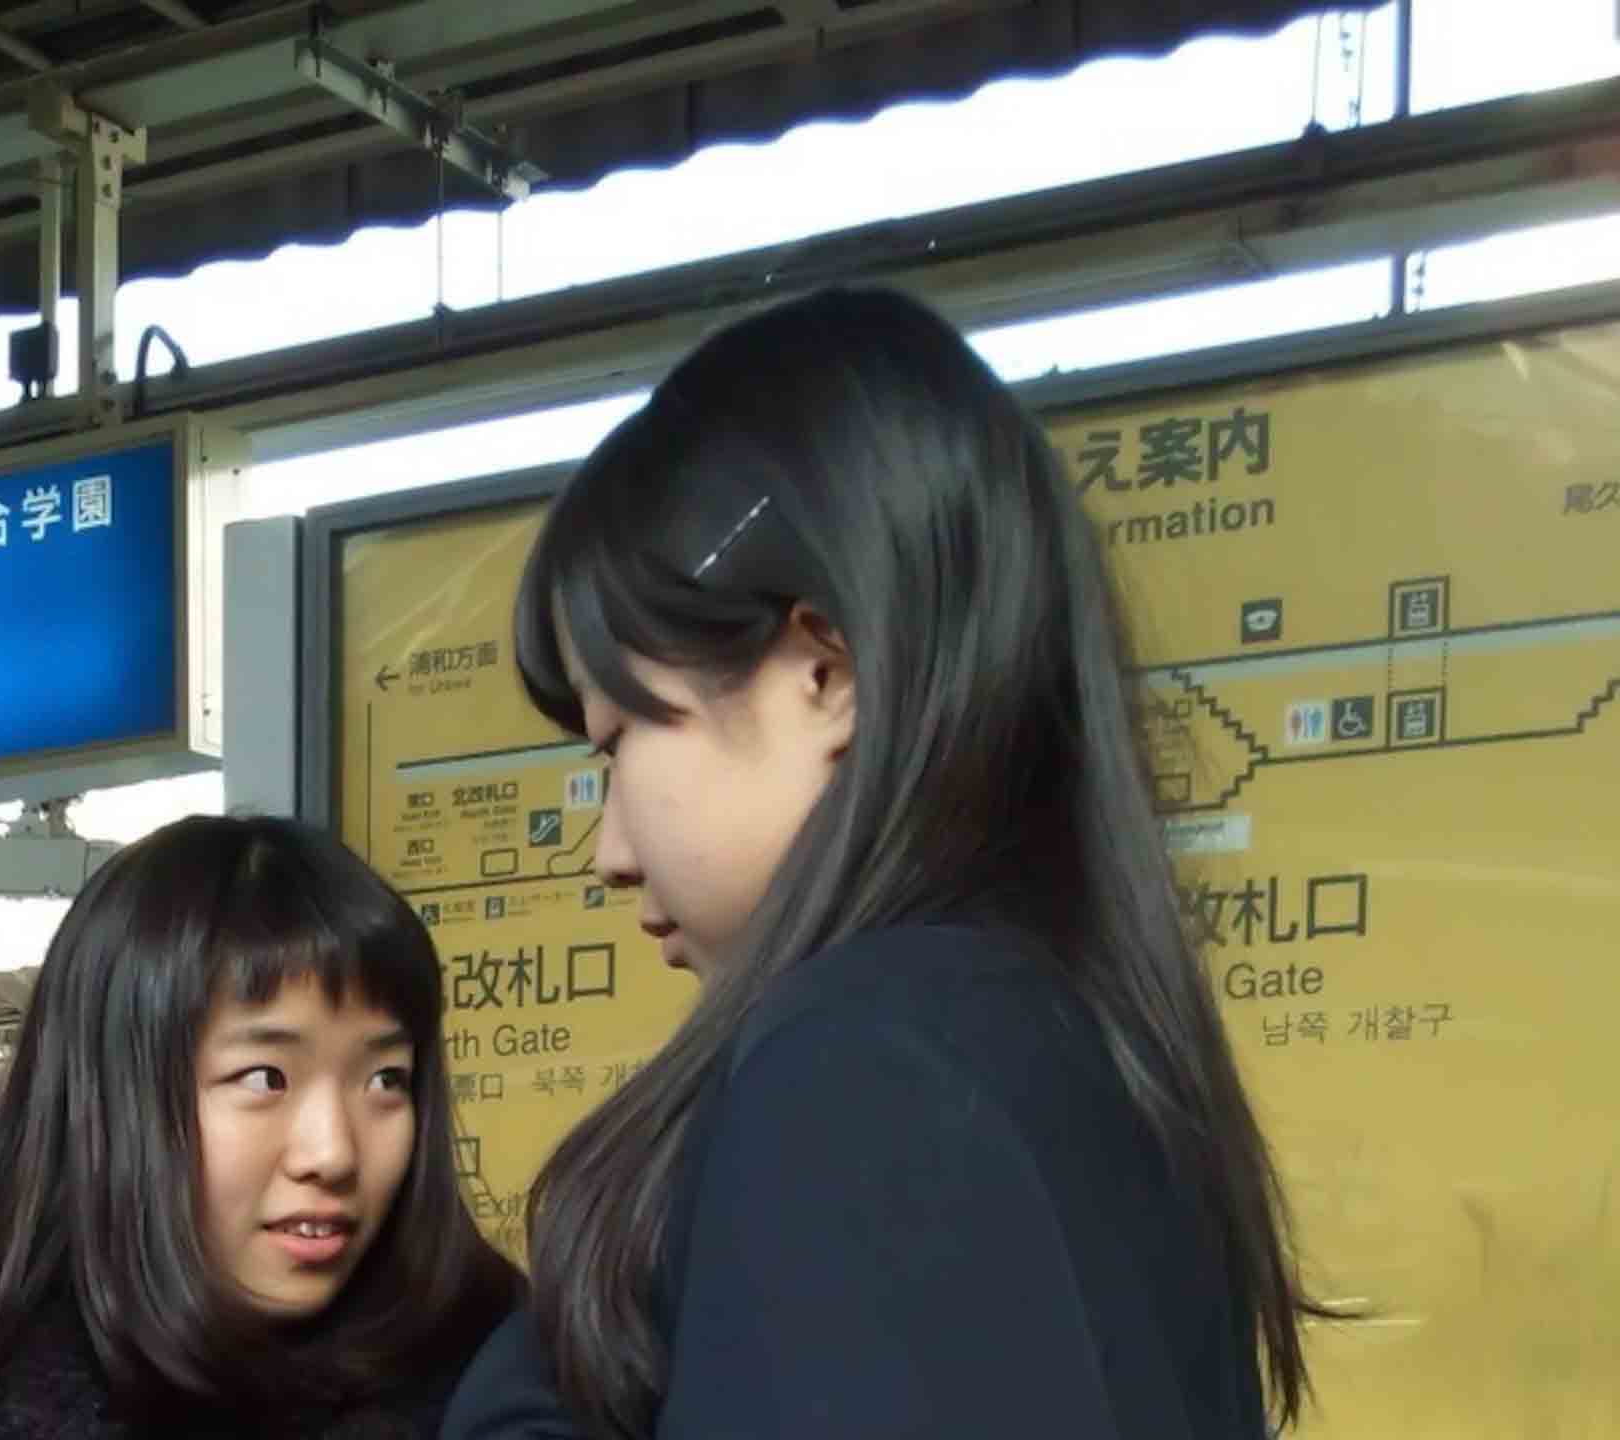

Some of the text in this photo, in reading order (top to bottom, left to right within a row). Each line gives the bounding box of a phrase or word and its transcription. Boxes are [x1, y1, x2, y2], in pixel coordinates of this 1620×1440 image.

[439, 943, 616, 1012] 改札口
[1224, 962, 1324, 1000] Gate
[492, 1024, 571, 1056] Gate
